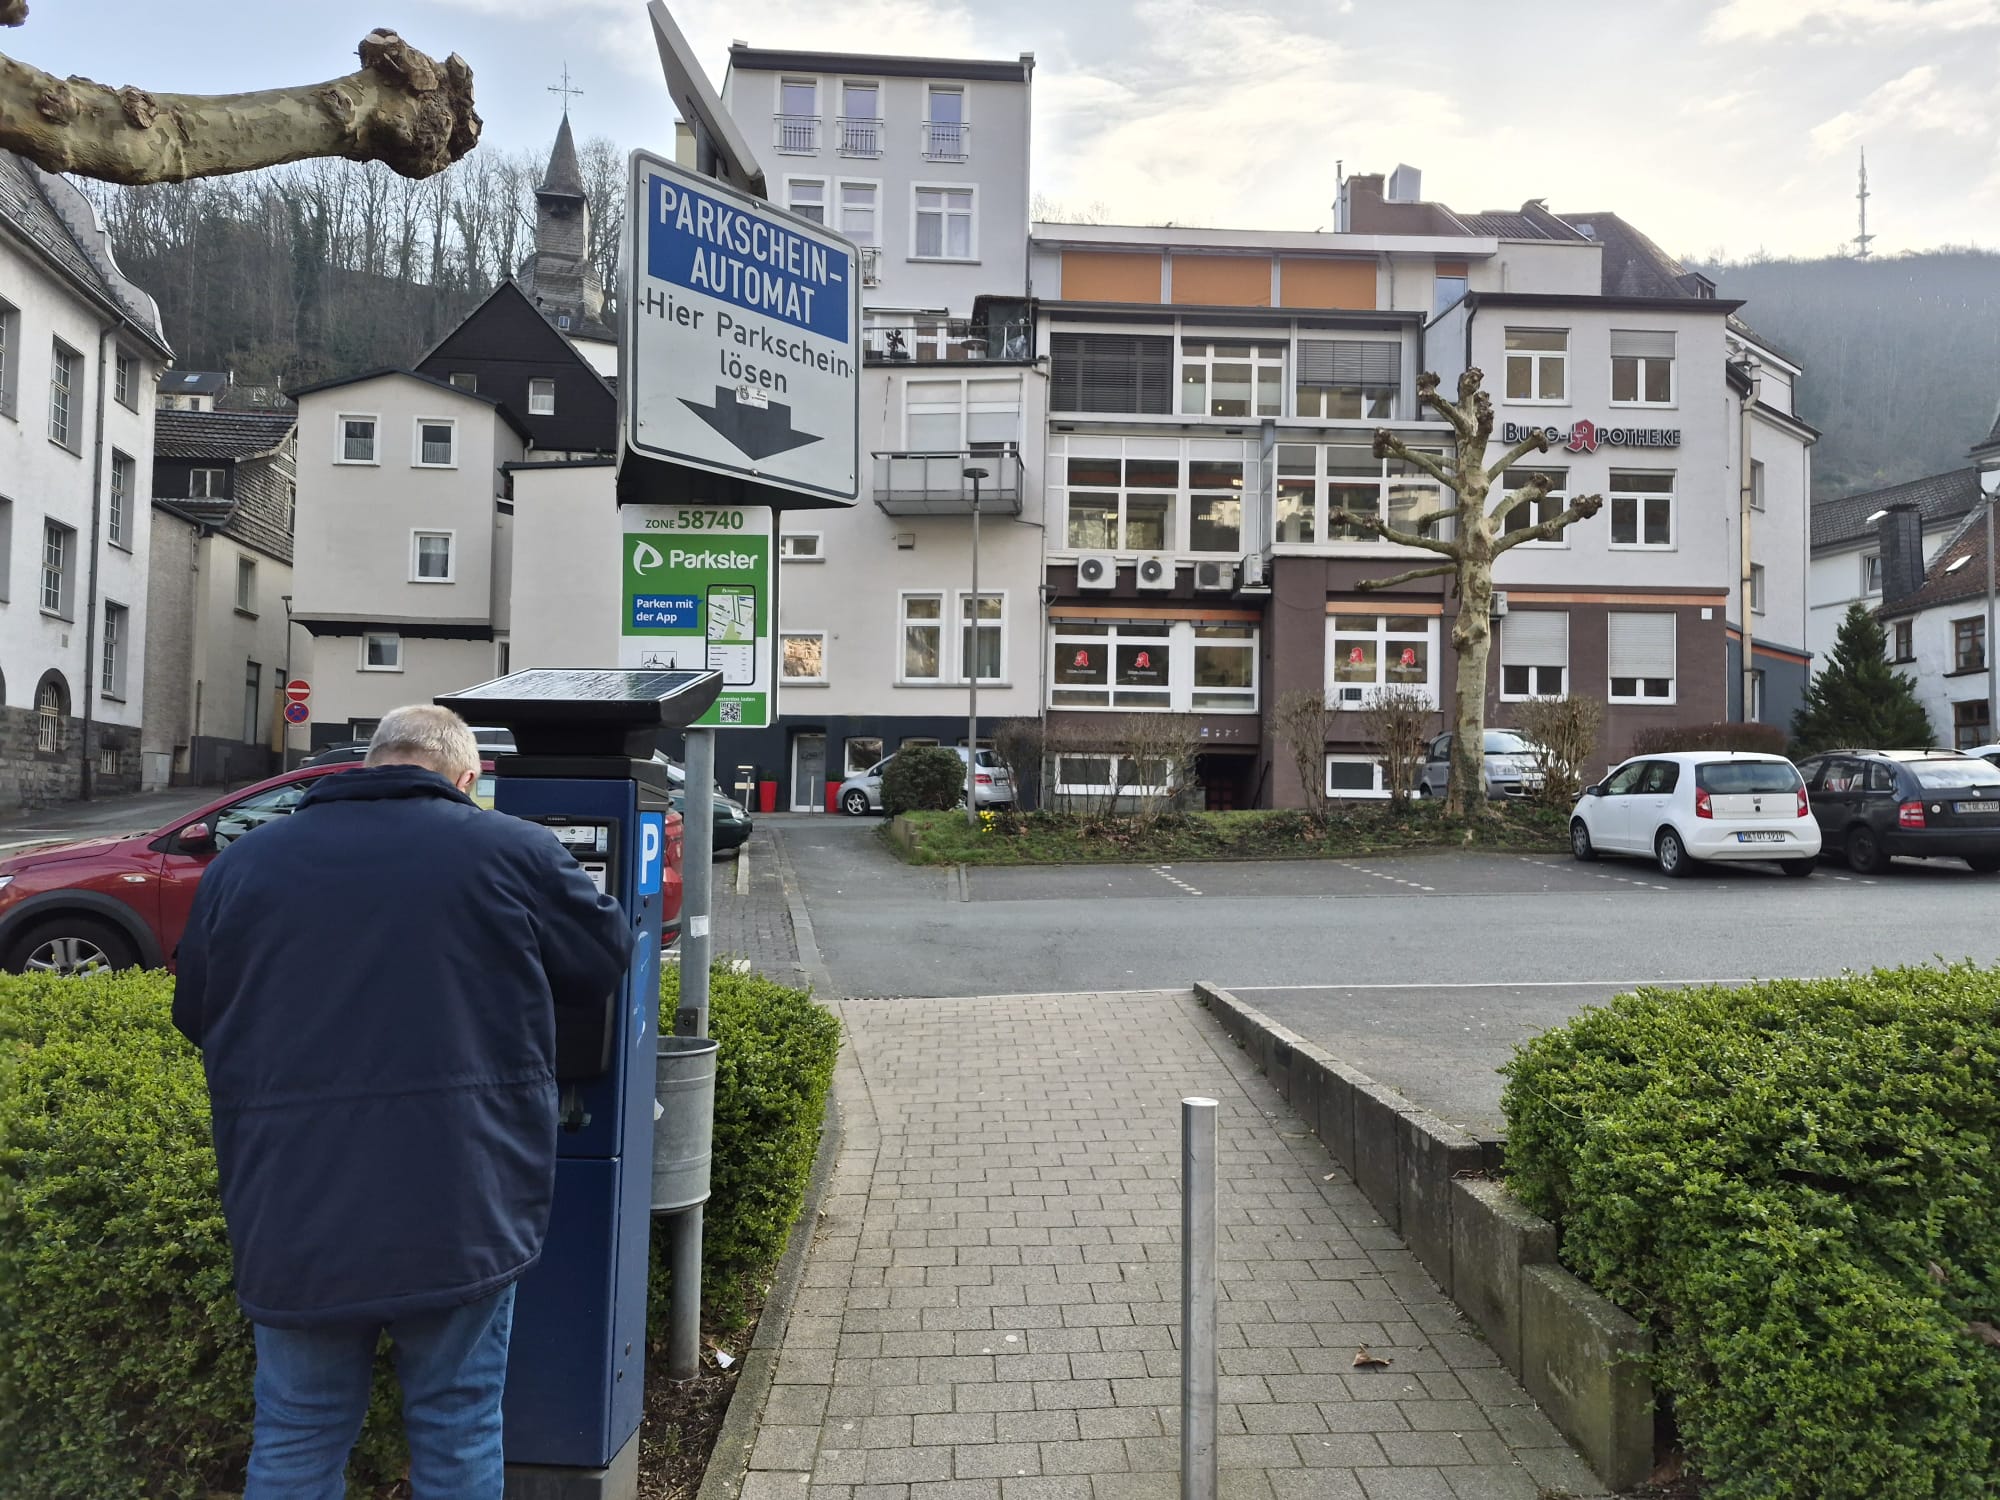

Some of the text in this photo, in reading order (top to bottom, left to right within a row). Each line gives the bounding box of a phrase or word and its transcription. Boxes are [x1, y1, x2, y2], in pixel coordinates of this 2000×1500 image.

[659, 183, 842, 286] PARKSCHEIN-
[690, 247, 815, 325] AUTOMAT
[646, 287, 850, 378] Hier Parkschein
[720, 349, 788, 394] lösen
[645, 510, 744, 530] ZONE 58740
[670, 549, 758, 570] Parkster
[636, 599, 693, 609] Parken mit
[636, 613, 678, 625] der App
[641, 823, 659, 884] P
